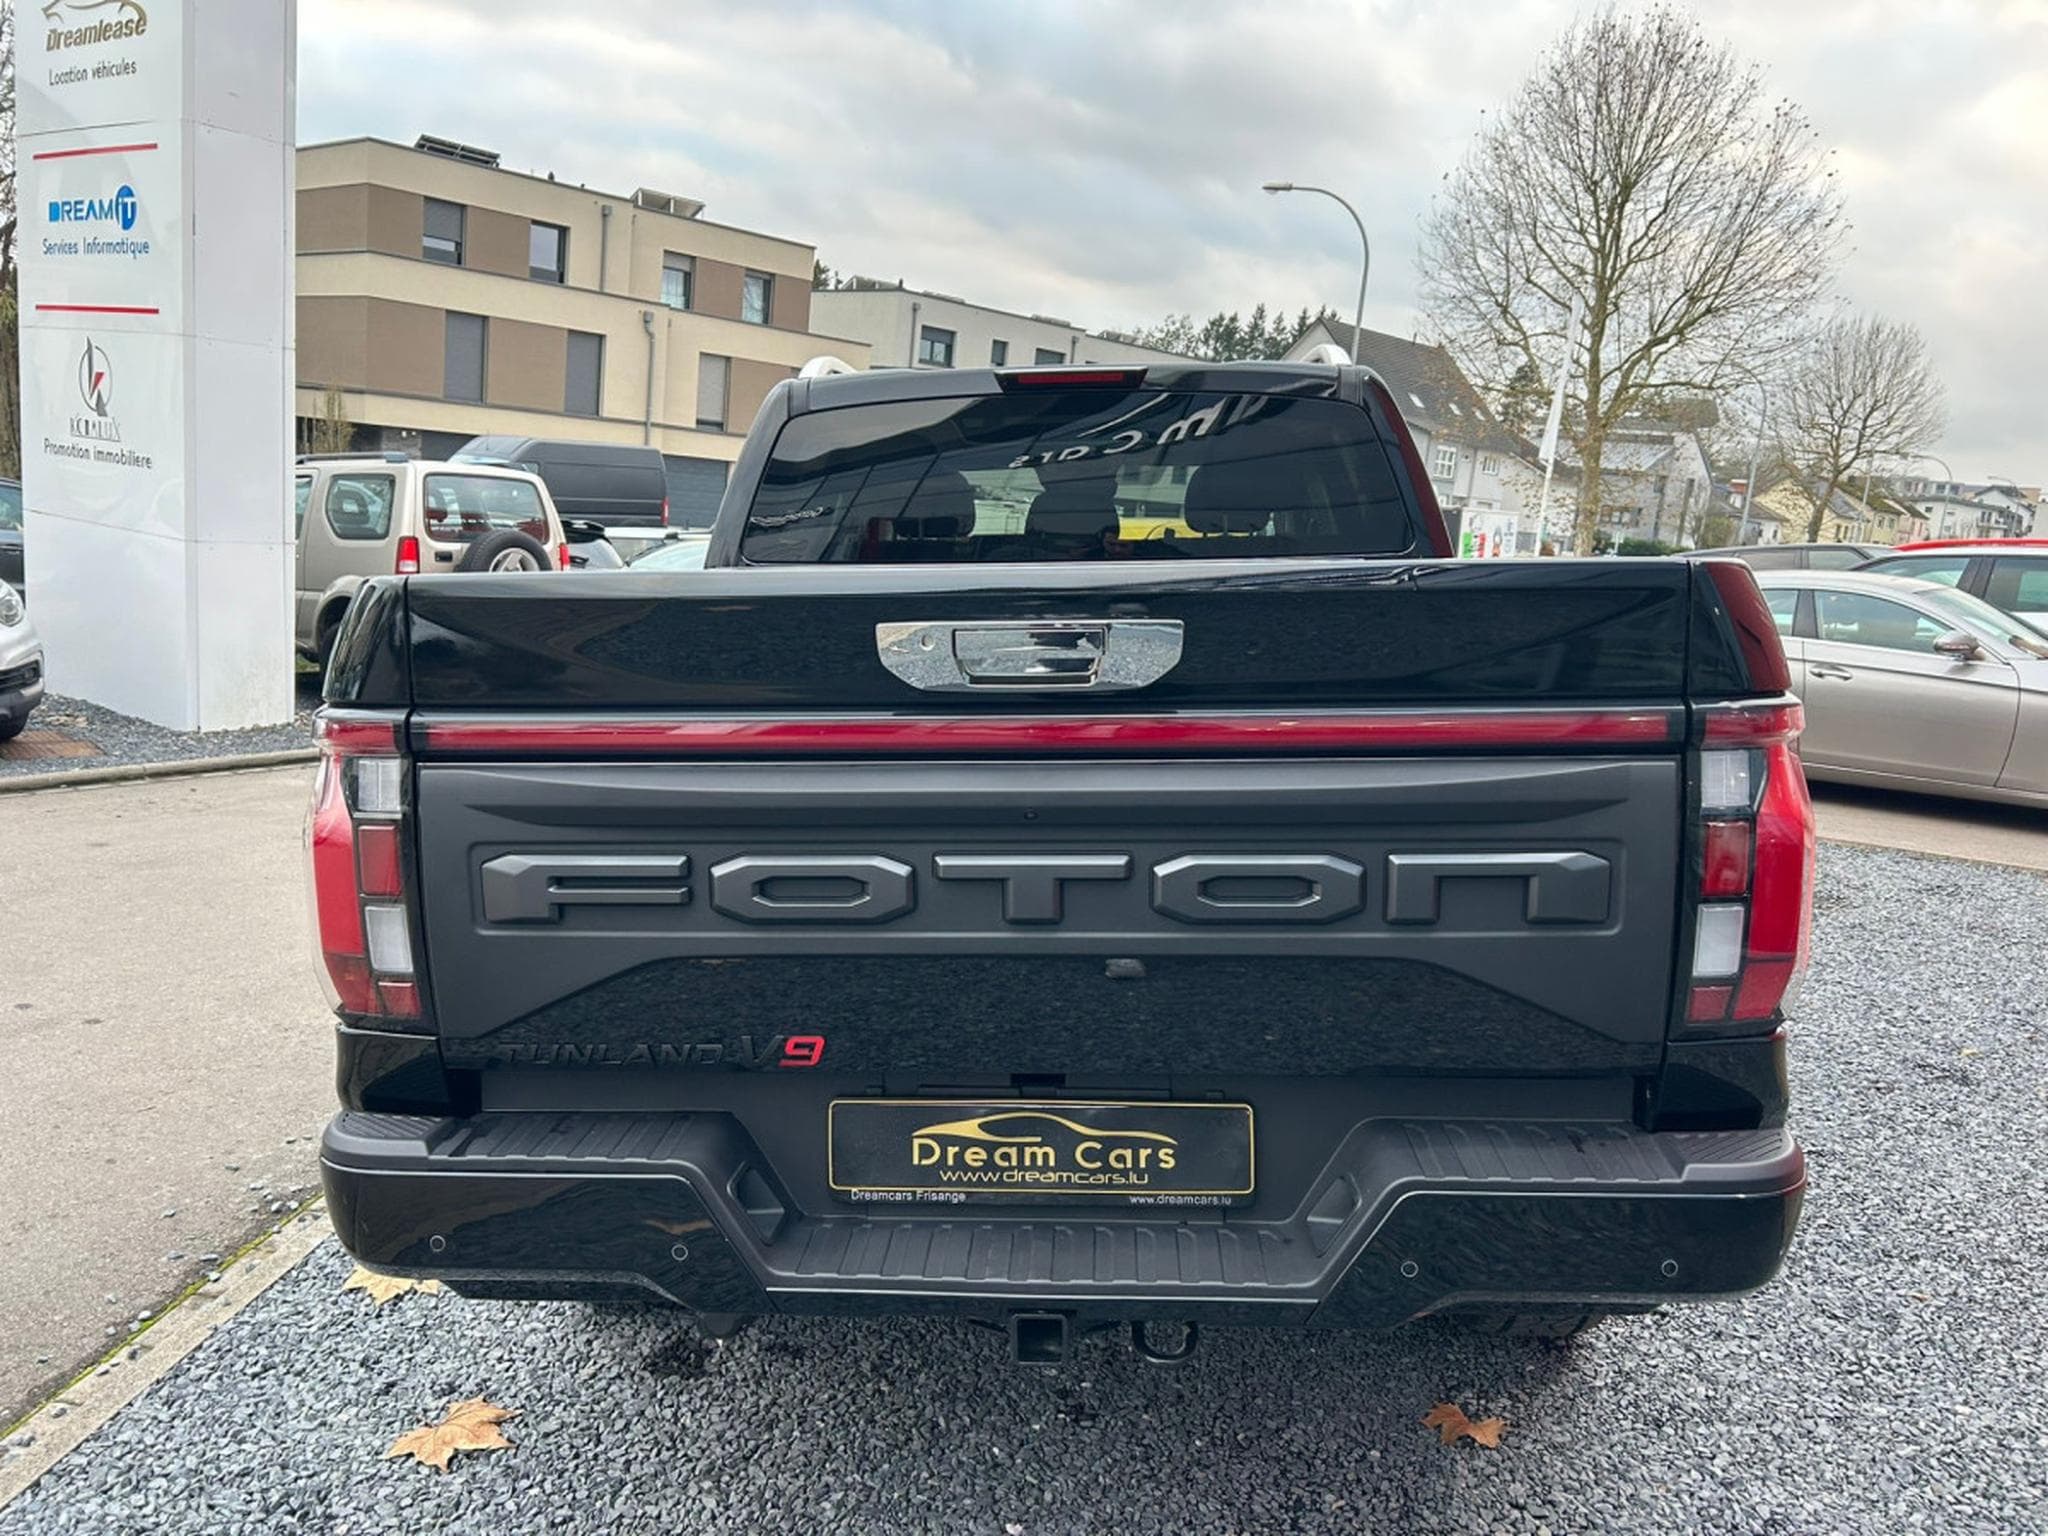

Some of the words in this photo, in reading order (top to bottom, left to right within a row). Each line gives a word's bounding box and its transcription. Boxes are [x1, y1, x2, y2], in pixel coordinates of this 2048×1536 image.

[46, 18, 146, 51] Dreamlease
[49, 67, 87, 85] Location
[42, 238, 79, 255] Services
[83, 237, 149, 259] Informatique
[43, 438, 90, 460] Promotion
[480, 852, 1612, 925] FOTON
[500, 1043, 724, 1065] TUNLAND
[740, 1034, 826, 1067] V9
[911, 1137, 1056, 1167] Dream
[1074, 1141, 1177, 1170] Cars
[939, 1170, 1149, 1185] www.dreamcars.lu
[850, 1188, 913, 1201] Dreamcars
[915, 1189, 967, 1203] Frisange
[1129, 1194, 1232, 1206] www.dreamcars.lu
